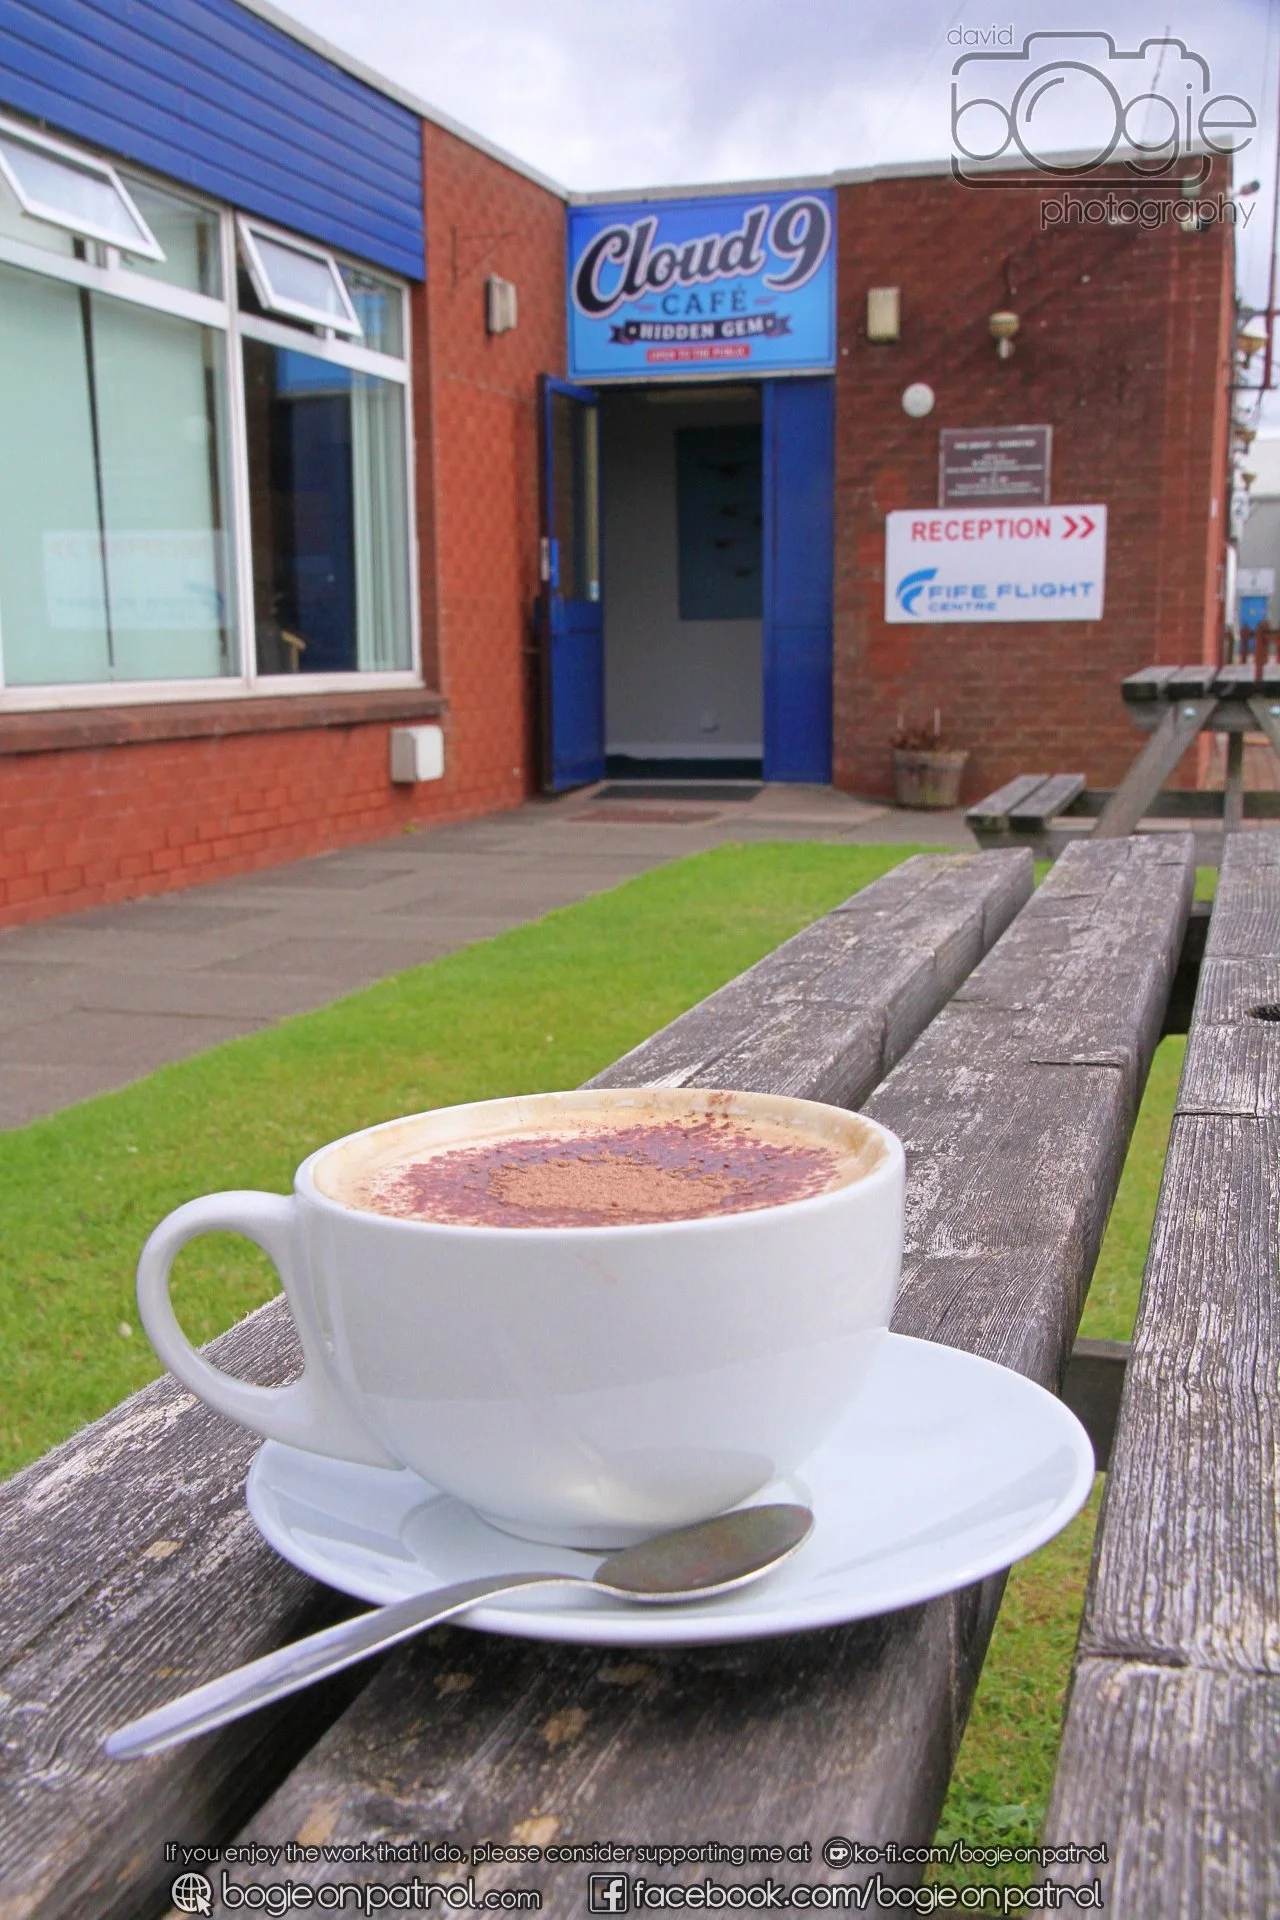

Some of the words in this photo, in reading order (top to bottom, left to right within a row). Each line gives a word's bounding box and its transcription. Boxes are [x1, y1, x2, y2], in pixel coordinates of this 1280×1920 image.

[572, 205, 767, 318] Cloud
[762, 196, 832, 291] 9
[661, 283, 747, 316] CAFÉ
[640, 321, 715, 341] HIDDEN
[721, 317, 764, 337] GEM
[911, 518, 1051, 542] RECEPTION
[928, 584, 988, 599] FIFE
[997, 582, 1094, 598] FLIGHT
[928, 601, 996, 612] CENTRE
